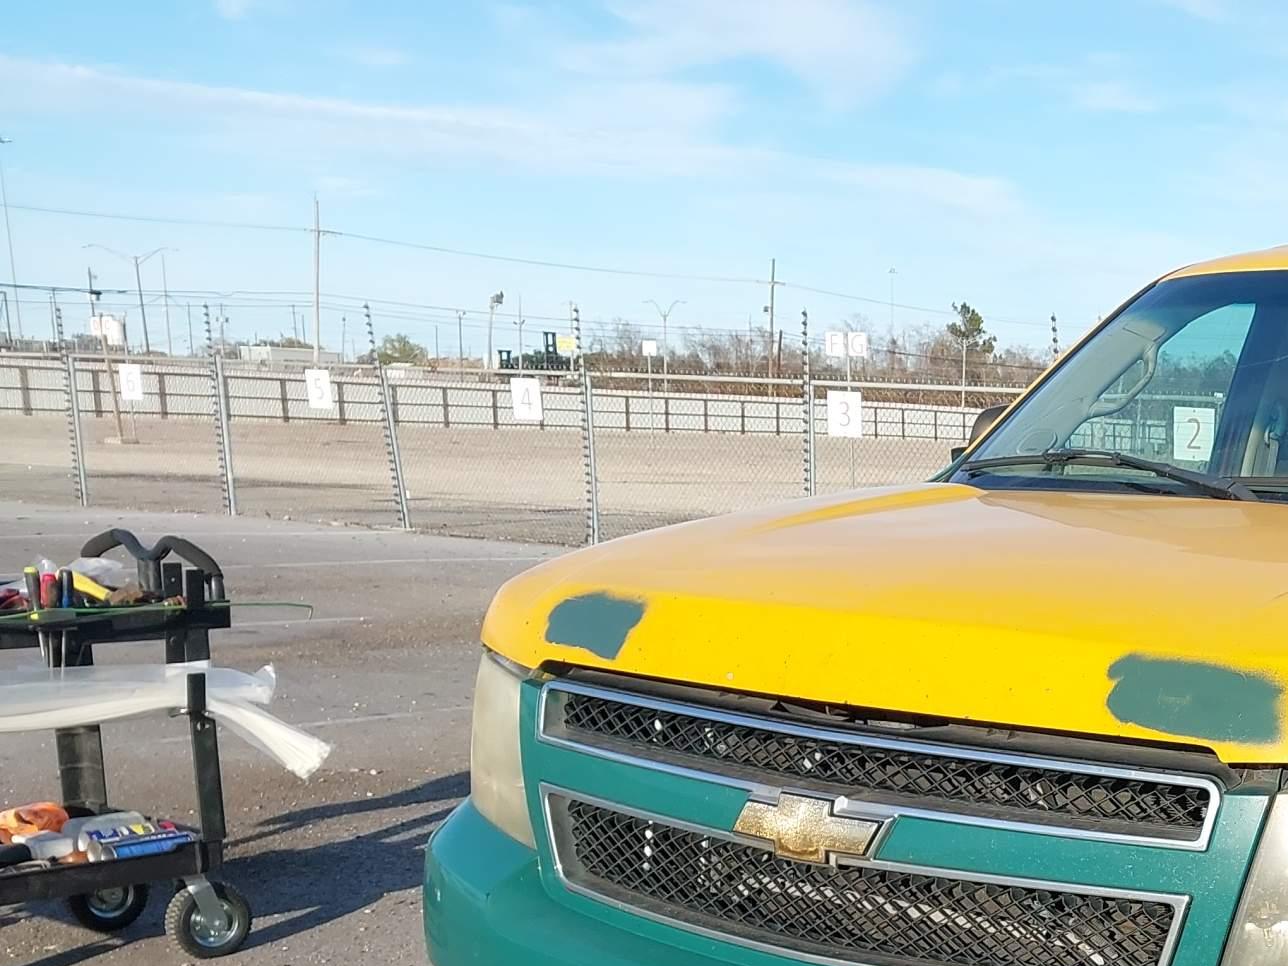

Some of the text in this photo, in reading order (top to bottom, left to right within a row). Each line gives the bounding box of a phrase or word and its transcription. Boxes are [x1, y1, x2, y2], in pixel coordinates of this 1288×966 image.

[850, 333, 864, 355] G
[126, 370, 136, 393] 6
[314, 377, 325, 400] 5
[519, 386, 532, 412] 4
[839, 400, 851, 427] 3
[1187, 417, 1201, 449] 2
